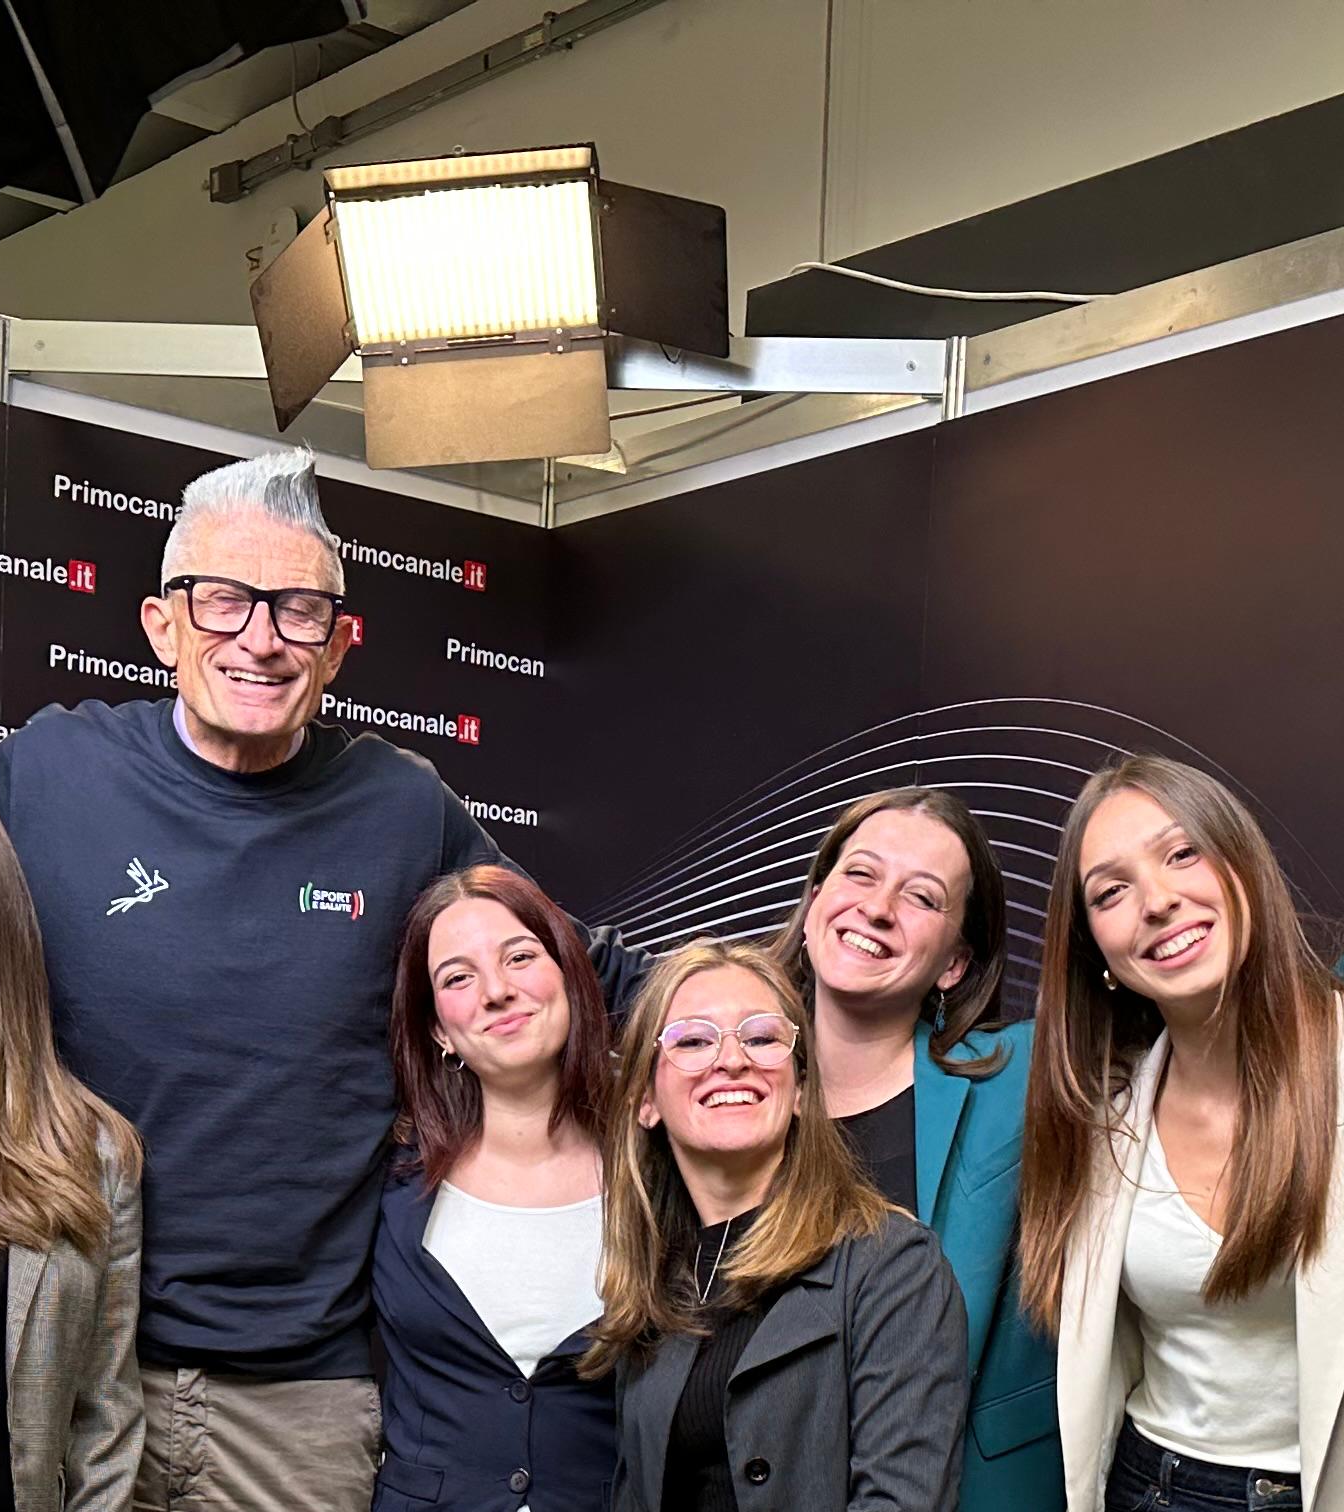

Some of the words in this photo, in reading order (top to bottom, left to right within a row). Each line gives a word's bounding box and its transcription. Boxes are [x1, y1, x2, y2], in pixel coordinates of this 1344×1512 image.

[446, 638, 544, 678] Primocan
[321, 693, 479, 742] Primocanale.it
[312, 889, 352, 904] SPORT
